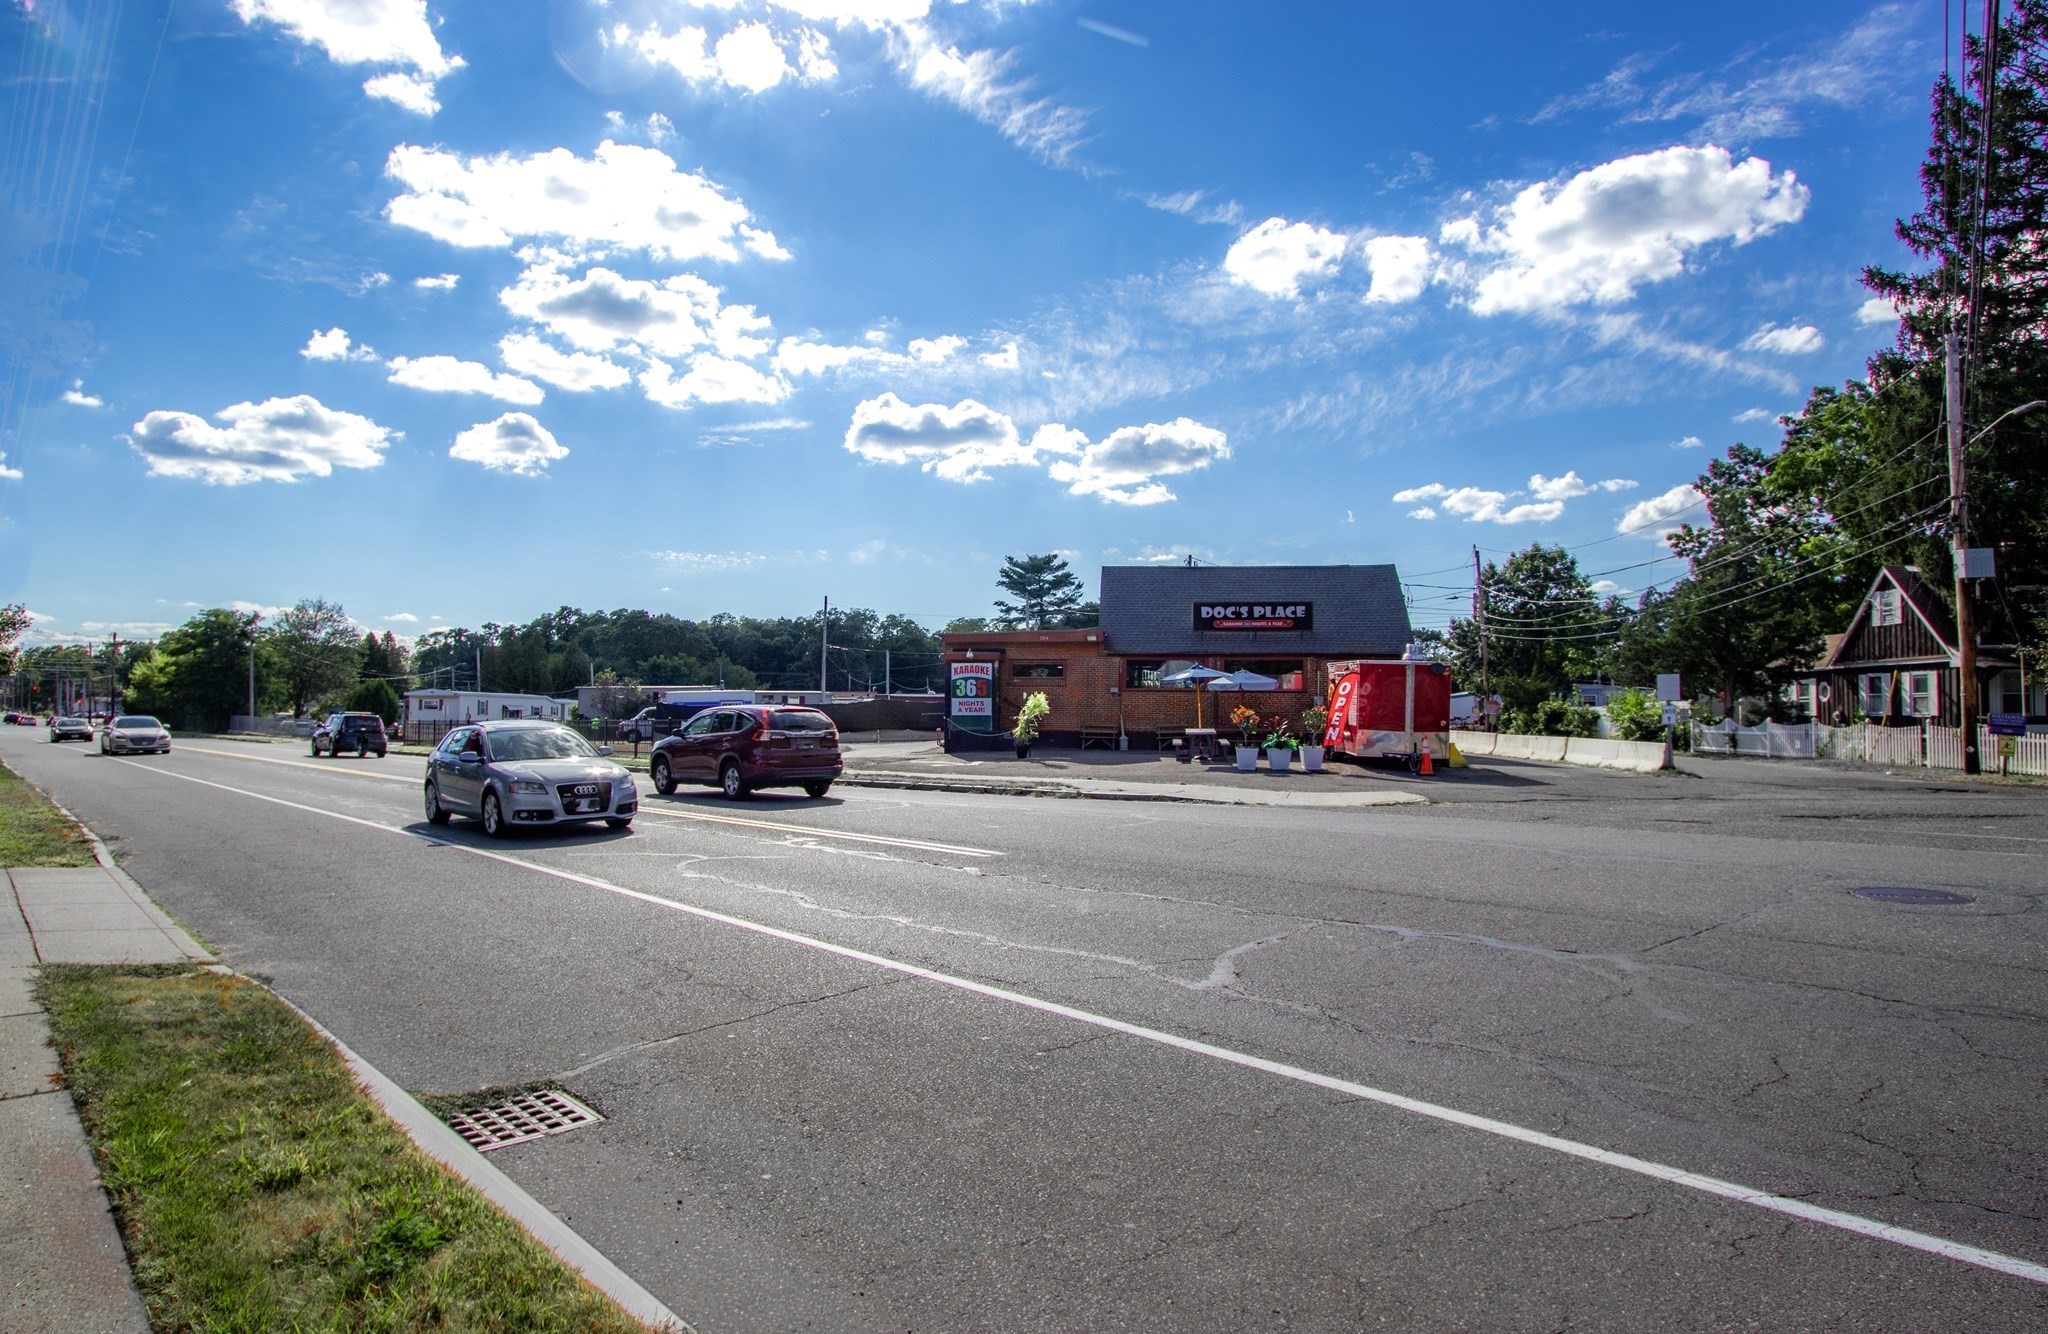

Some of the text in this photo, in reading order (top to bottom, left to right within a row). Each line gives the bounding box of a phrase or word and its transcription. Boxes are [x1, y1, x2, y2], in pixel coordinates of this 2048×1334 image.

[1201, 605, 1306, 618] DOC'S PLACE
[953, 665, 990, 676] KARAOKE
[955, 678, 987, 697] 365
[1325, 681, 1352, 741] OPEN
